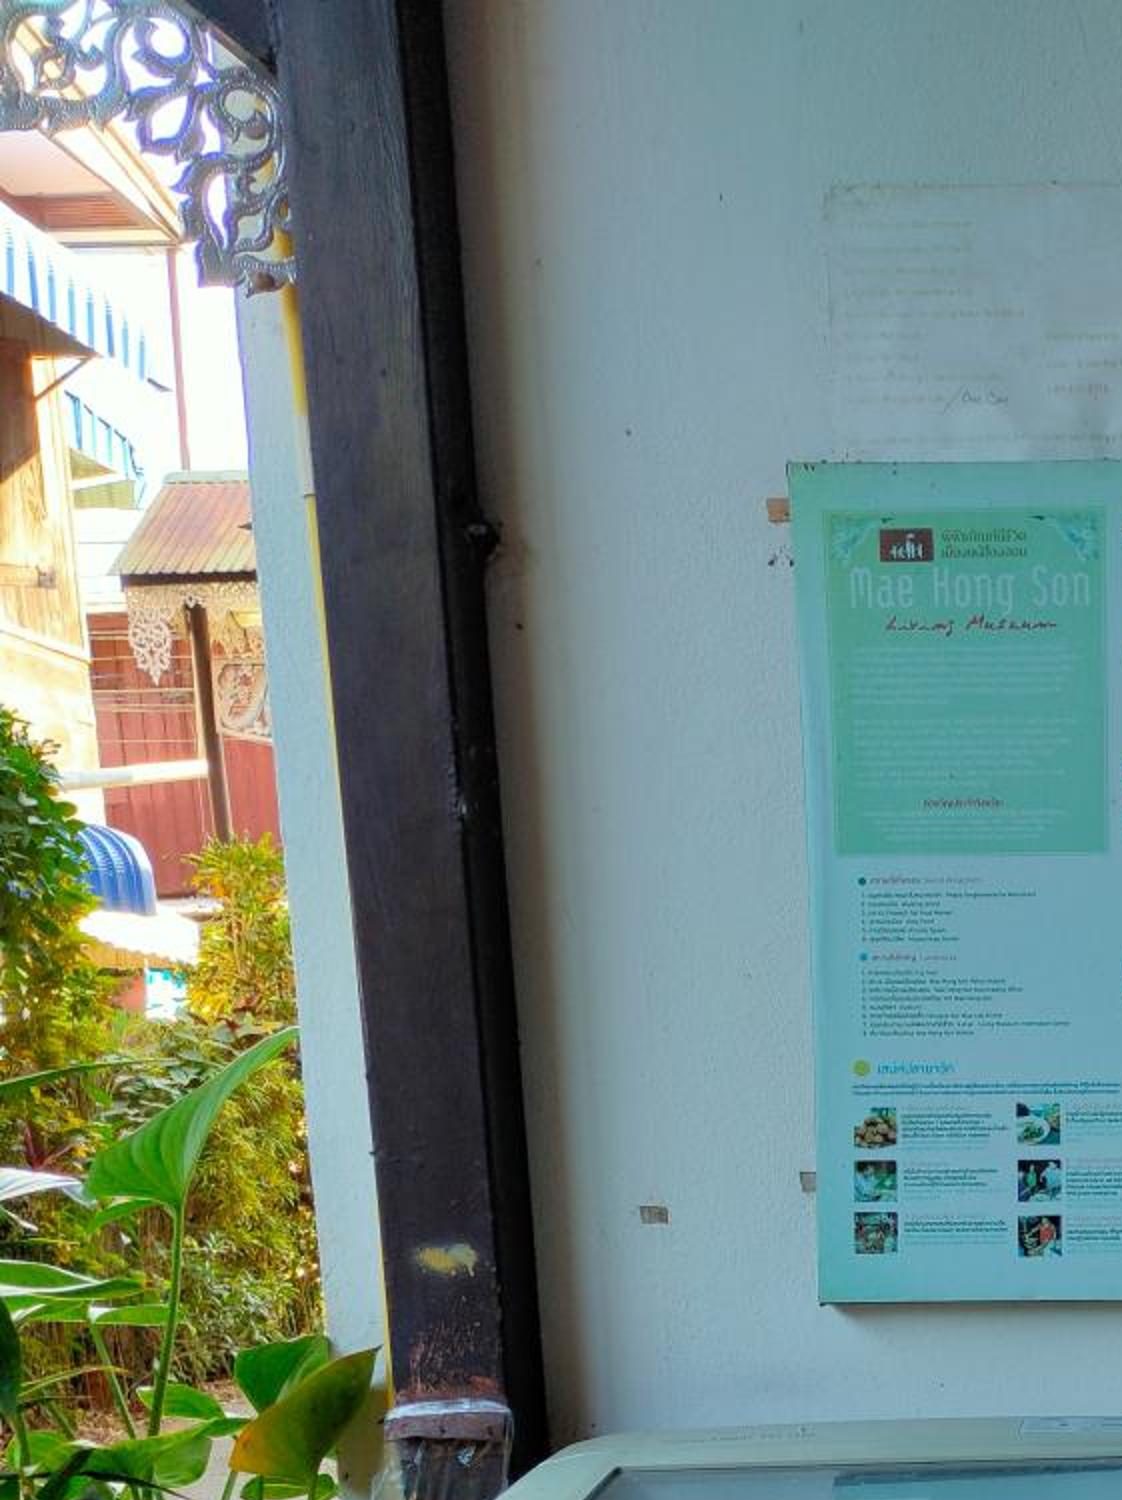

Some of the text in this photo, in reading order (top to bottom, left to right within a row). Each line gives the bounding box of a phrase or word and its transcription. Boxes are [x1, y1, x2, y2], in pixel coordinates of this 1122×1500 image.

[850, 564, 1090, 614] Mae Hong Son
